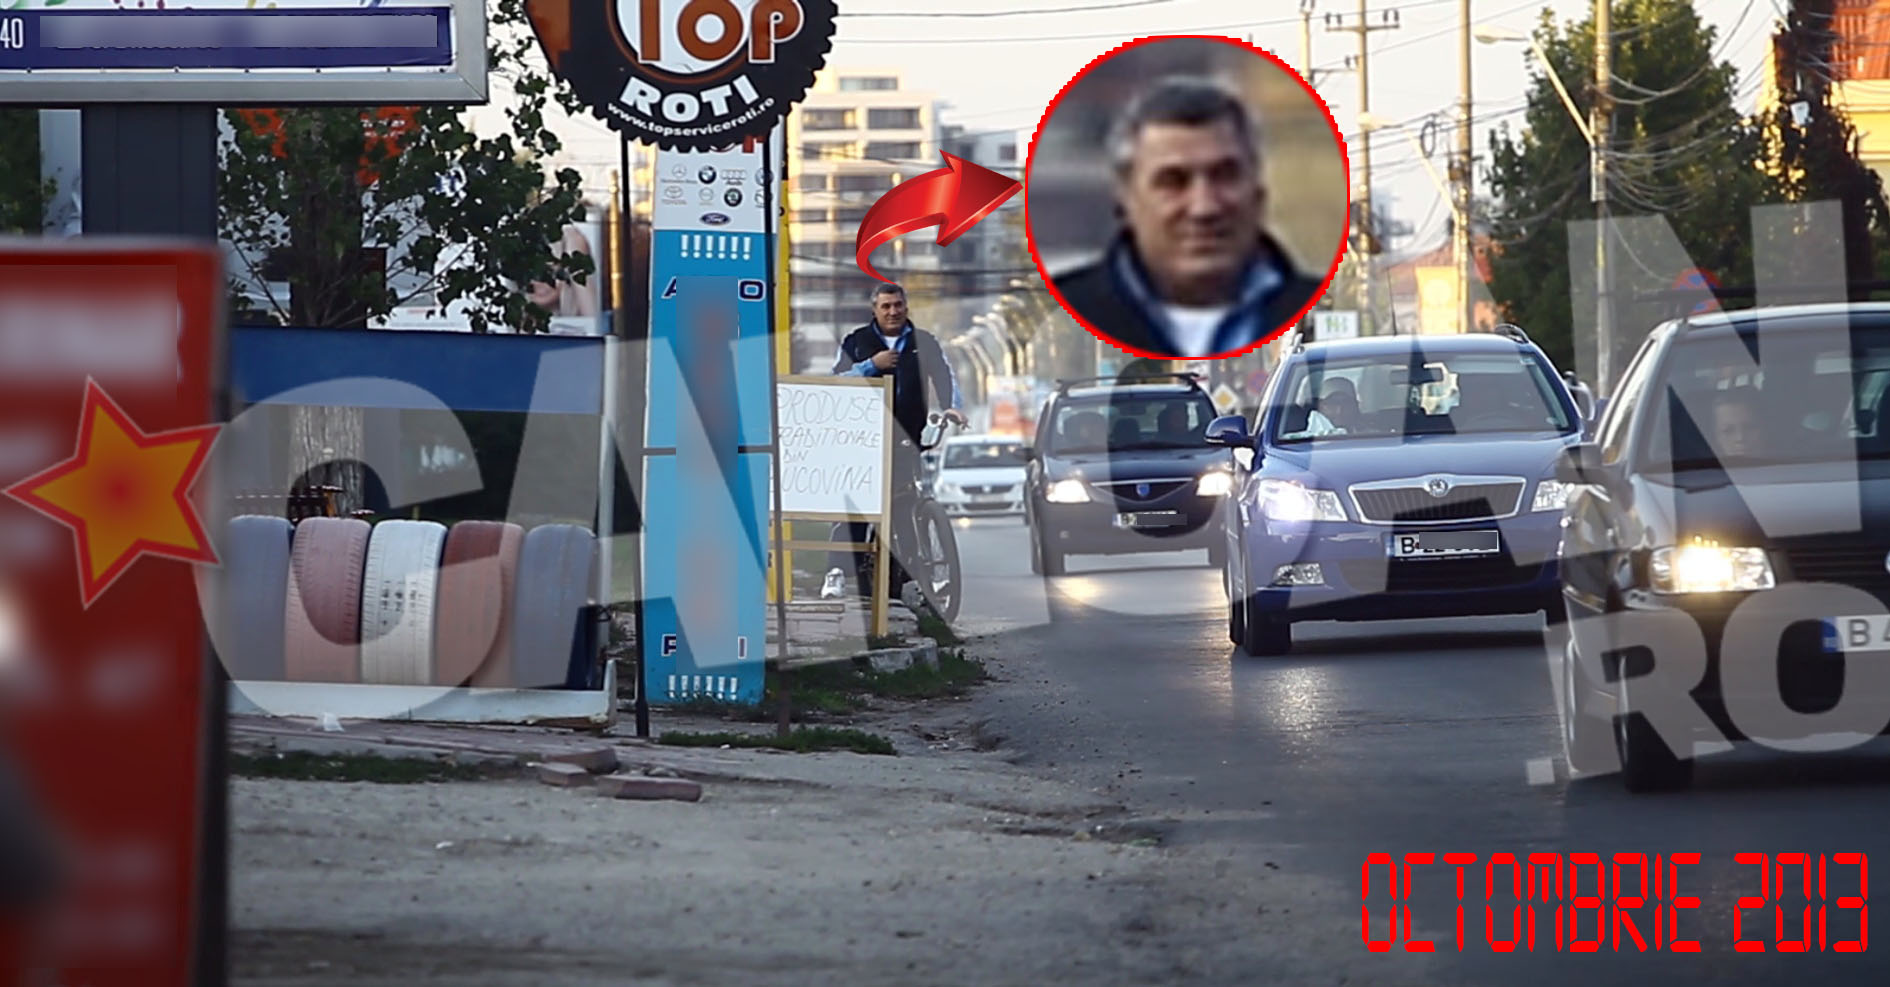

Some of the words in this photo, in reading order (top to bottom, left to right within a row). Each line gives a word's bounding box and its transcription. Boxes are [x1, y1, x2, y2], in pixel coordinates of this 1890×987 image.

[608, 97, 775, 137] www.topserviceroti.ro
[620, 75, 760, 123] ROTI
[778, 387, 880, 425] PRODUSE
